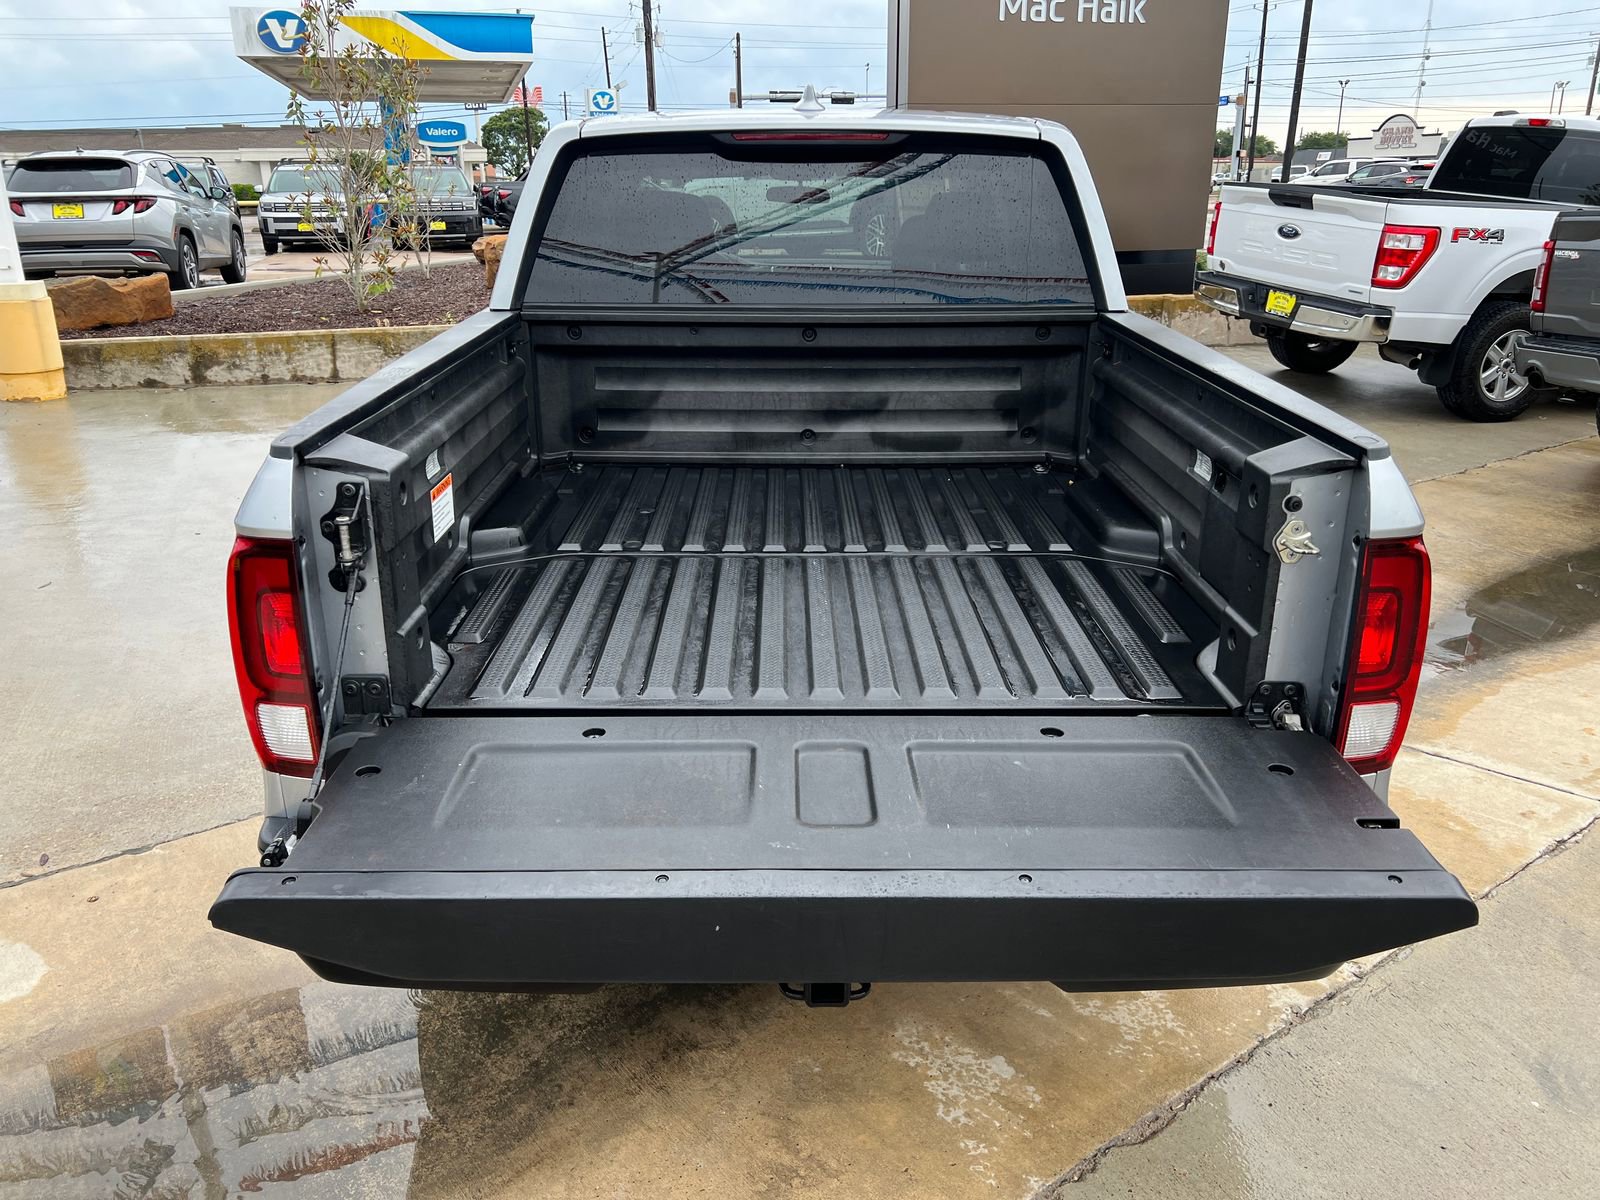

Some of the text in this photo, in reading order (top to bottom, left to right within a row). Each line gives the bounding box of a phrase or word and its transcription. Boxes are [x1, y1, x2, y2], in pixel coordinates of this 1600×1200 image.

[999, 0, 1065, 22] Mac
[425, 127, 458, 136] Valero
[1451, 227, 1505, 243] FX4
